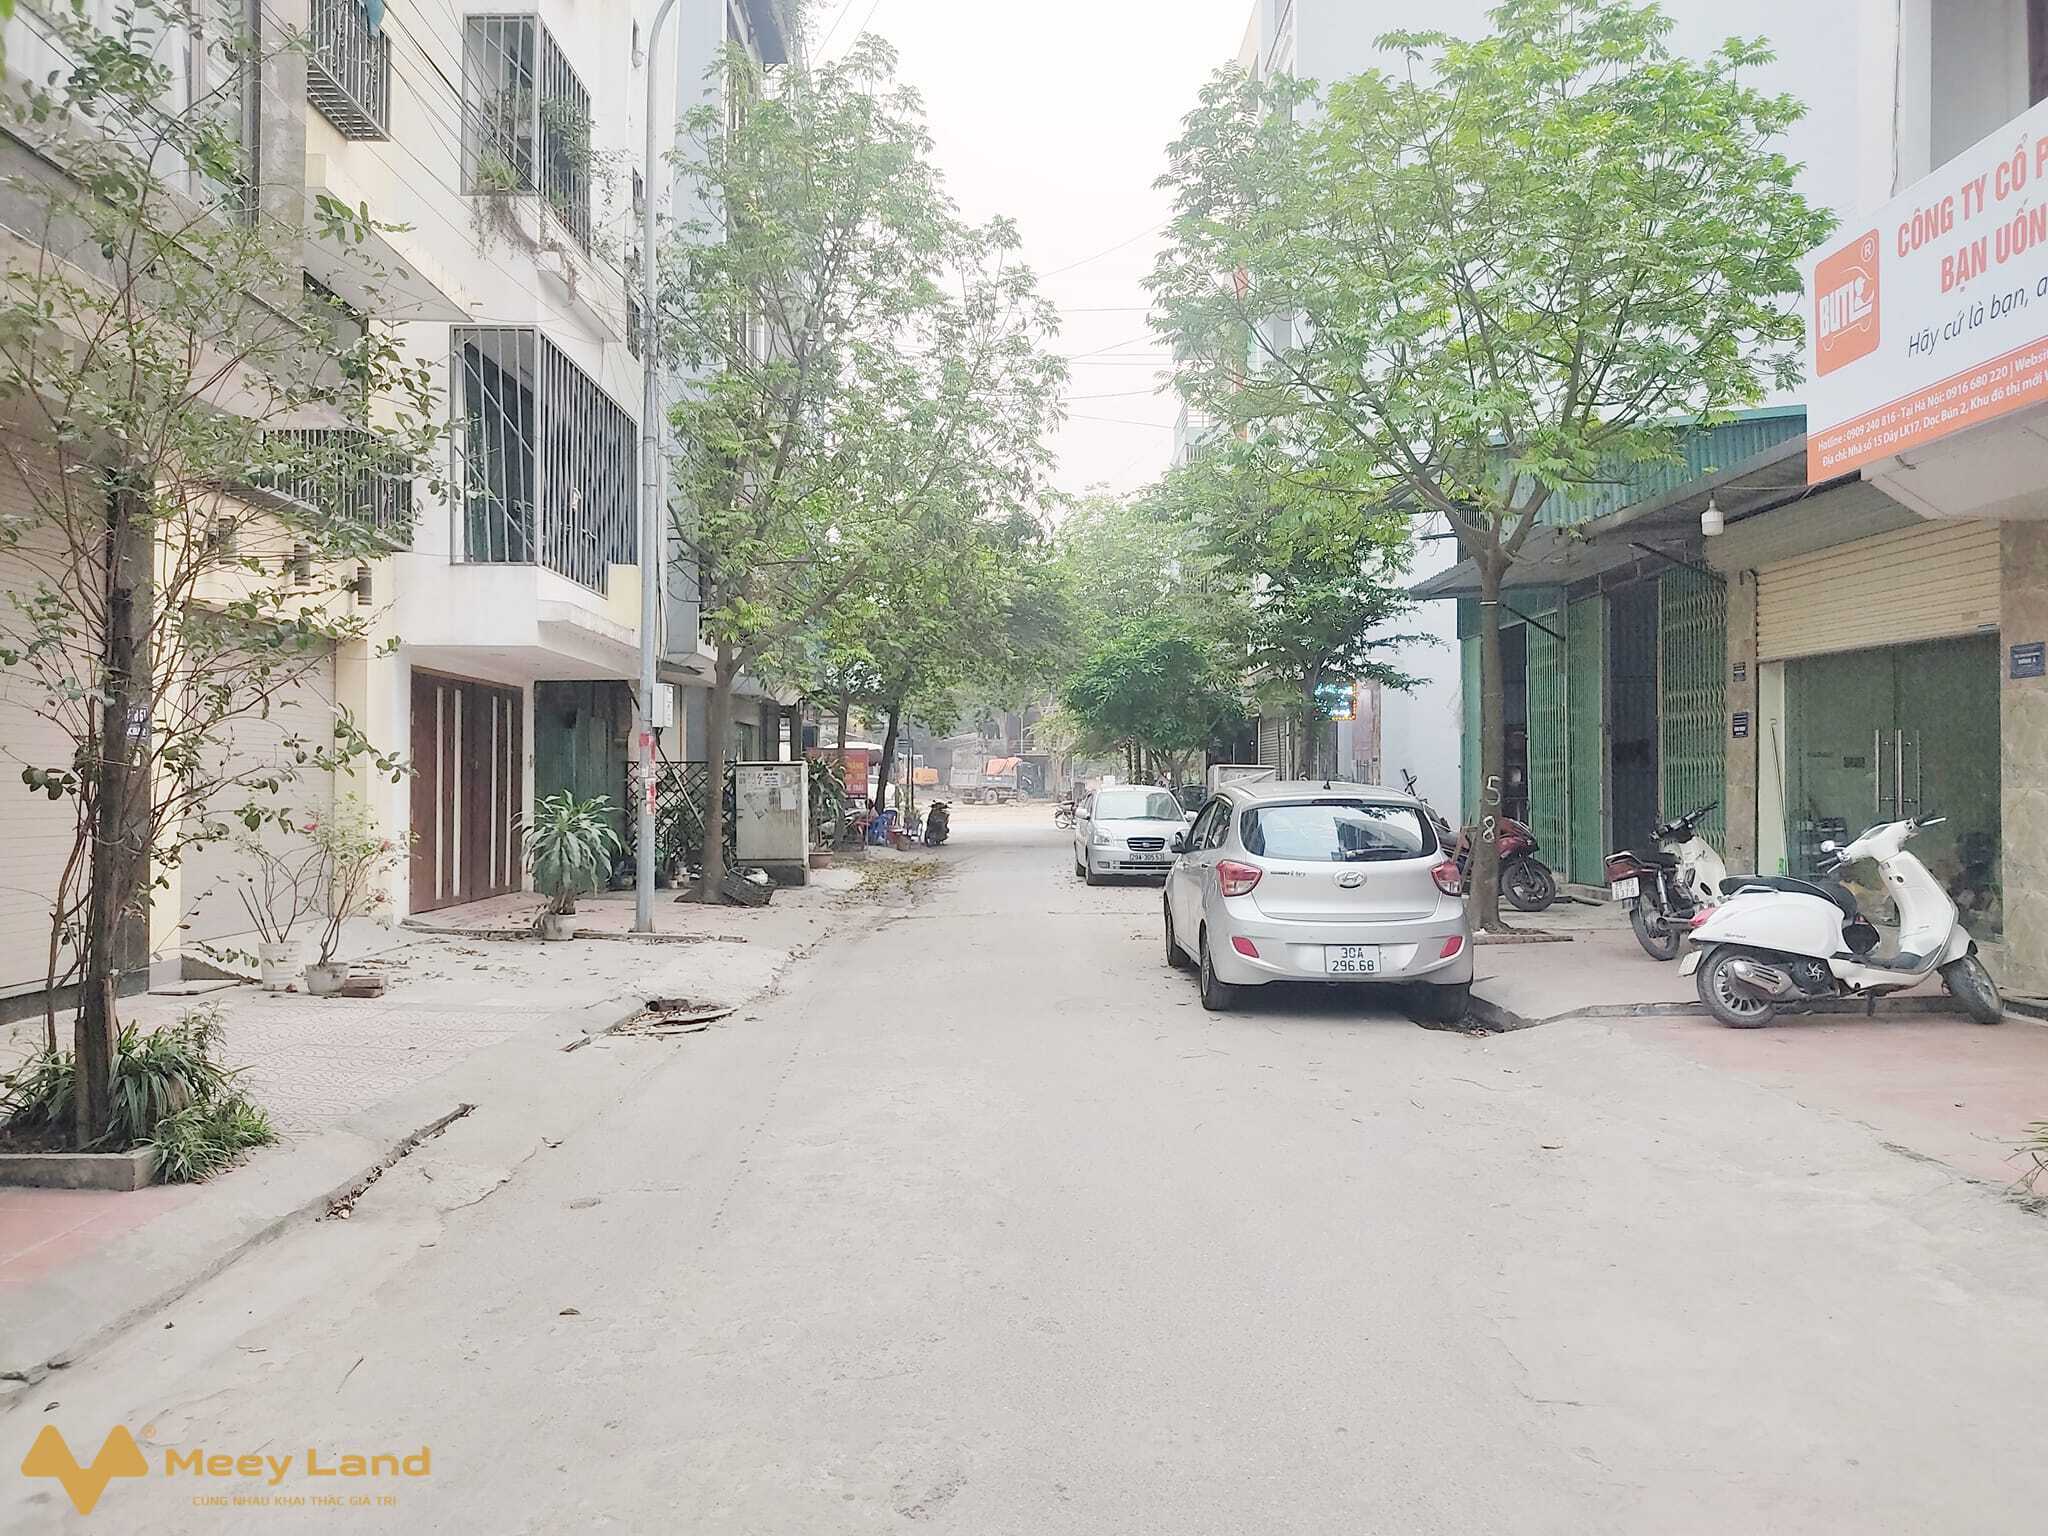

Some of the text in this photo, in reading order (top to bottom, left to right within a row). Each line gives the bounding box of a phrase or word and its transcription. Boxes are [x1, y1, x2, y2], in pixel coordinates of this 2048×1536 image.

[1897, 195, 1954, 258] CÔNG
[1961, 172, 1988, 221] TY
[1995, 132, 2027, 201] CỔ
[1941, 235, 1988, 294] BẠN
[1907, 327, 1939, 358] Hãy
[1968, 301, 1985, 329] là
[1990, 287, 2029, 319] bạn,
[1945, 381, 1969, 400] 0916
[1969, 374, 1988, 391] 680
[1989, 365, 2008, 382] 220
[1969, 395, 1989, 411] Khu
[1331, 959, 1375, 972] 296.68
[1340, 946, 1364, 959] 30A
